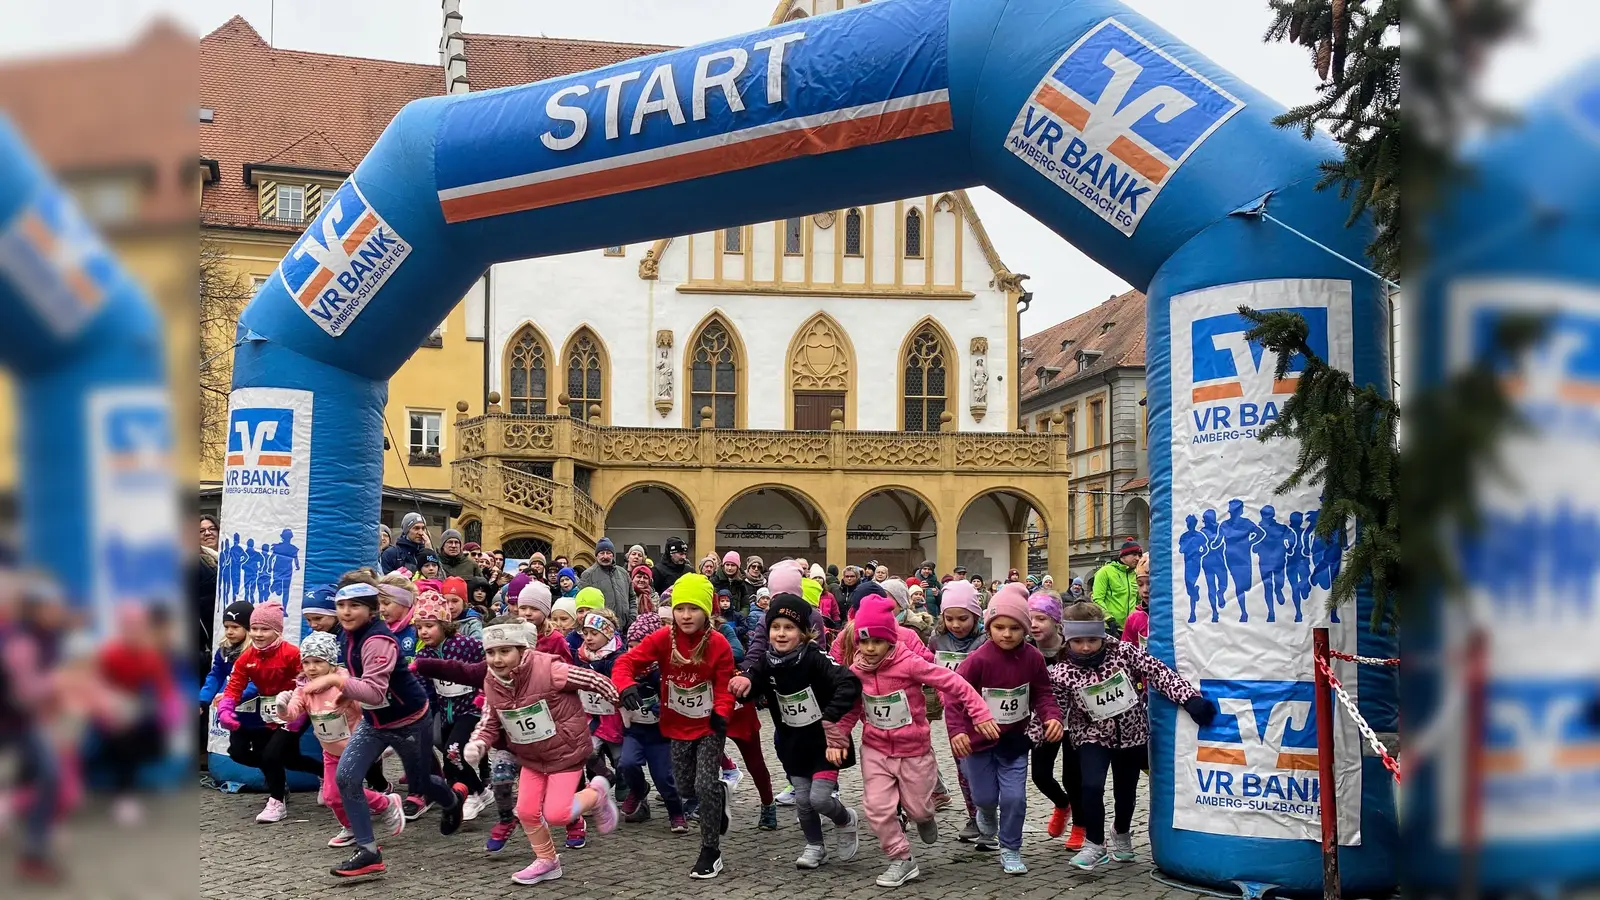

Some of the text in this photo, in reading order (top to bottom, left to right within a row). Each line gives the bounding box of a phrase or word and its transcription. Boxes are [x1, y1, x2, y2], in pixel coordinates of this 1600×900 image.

[539, 32, 805, 151] START
[1022, 105, 1151, 215] VR BANK
[1010, 135, 1133, 227] AMBERG-SULZBACH EG
[310, 226, 397, 321] VR BANK
[330, 243, 405, 333] AMBERG-SULZBACH EG
[1192, 401, 1286, 432] VR BA
[226, 469, 290, 487] VR BANK
[677, 695, 704, 708] 452
[1000, 698, 1019, 711] 48
[1096, 686, 1125, 706] 444
[782, 702, 808, 716] 454
[874, 705, 891, 718] 47
[319, 722, 327, 733] 1
[516, 717, 537, 732] 16
[1196, 768, 1234, 795] VR
[1195, 795, 1314, 815] AMBERG-SULZBACH
